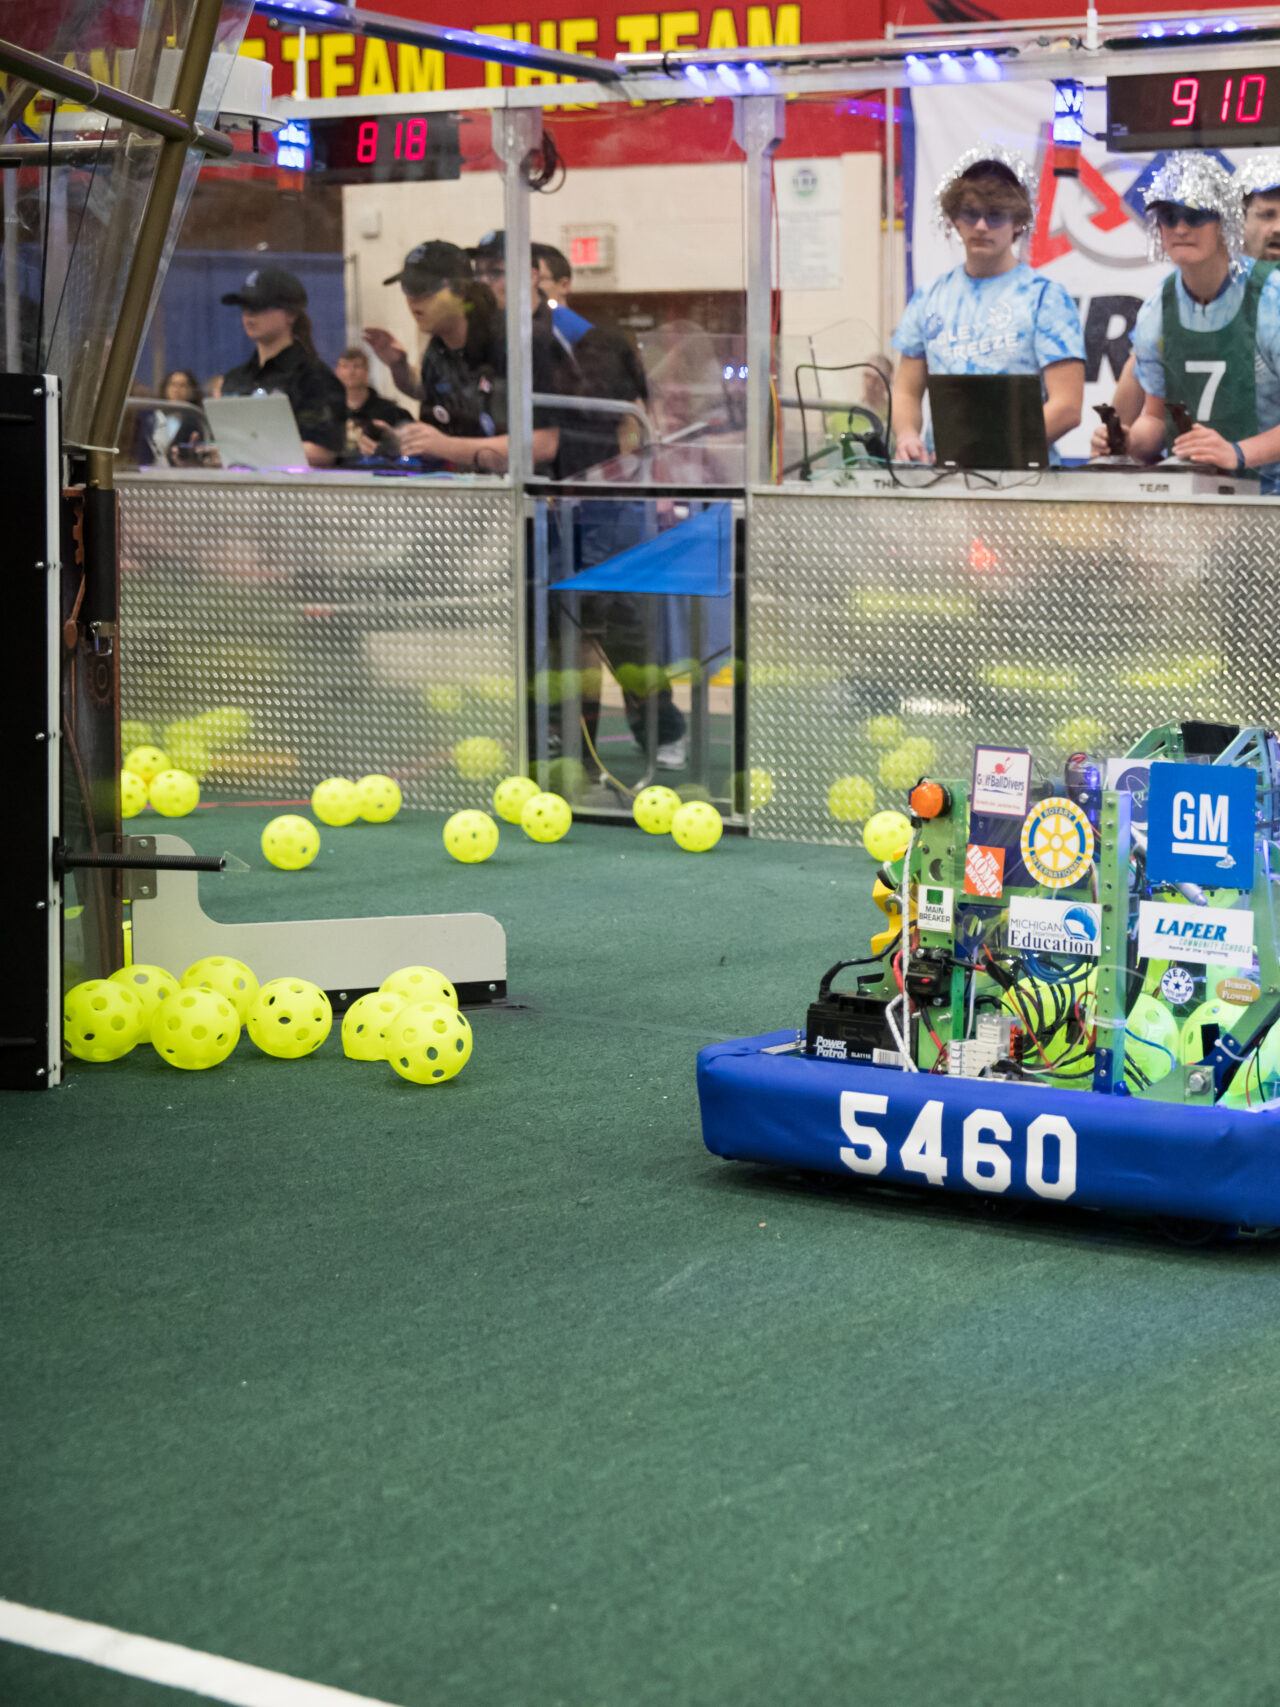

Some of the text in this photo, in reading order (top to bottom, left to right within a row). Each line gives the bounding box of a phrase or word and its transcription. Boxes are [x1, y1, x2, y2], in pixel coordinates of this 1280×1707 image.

[281, 33, 446, 99] TEAM
[616, 4, 801, 106] TEAM
[1170, 74, 1267, 126] 910
[356, 117, 428, 163] 818
[1185, 360, 1226, 421] 7
[1044, 806, 1074, 821] ROTARY
[1172, 791, 1229, 843] GM
[967, 845, 1003, 898] HOME
[984, 851, 1001, 872] THE
[965, 864, 988, 897] DEPOT
[918, 912, 951, 924] BREAKER
[925, 905, 945, 915] MAIN
[1010, 918, 1062, 932] MICHIGAN
[1155, 918, 1227, 942] LAPEER
[1010, 930, 1094, 955] Education
[815, 1036, 847, 1050] Power
[816, 1047, 848, 1059] Patrol
[839, 1090, 1077, 1201] 5460
